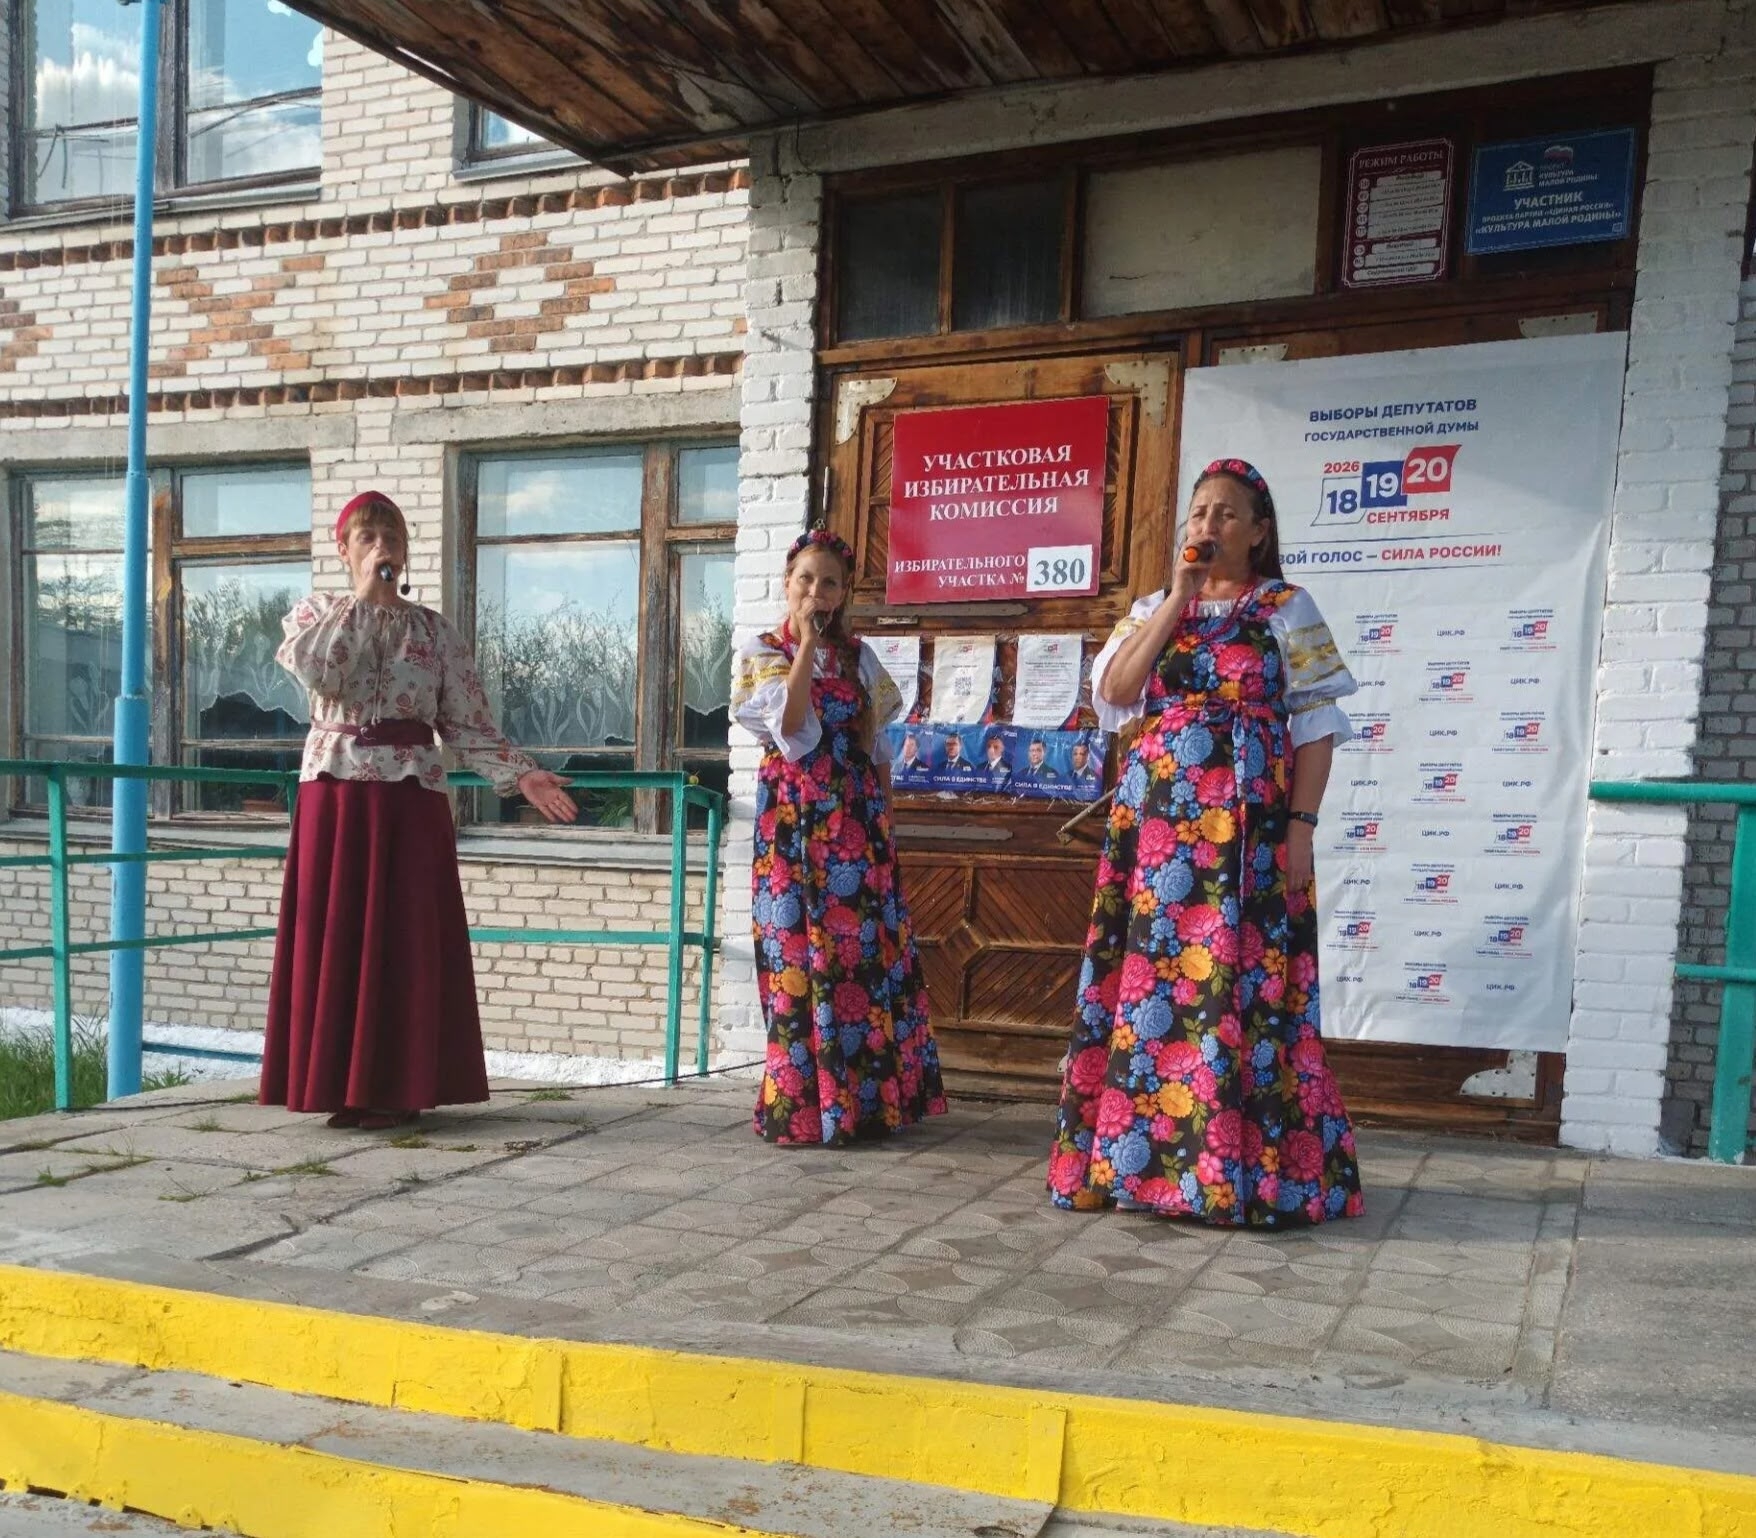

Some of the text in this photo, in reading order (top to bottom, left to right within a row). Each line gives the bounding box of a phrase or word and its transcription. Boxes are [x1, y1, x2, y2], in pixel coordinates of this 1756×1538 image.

[1400, 150, 1444, 165] РАБОТЫ
[1514, 191, 1584, 209] УЧАСТНИК
[1532, 215, 1569, 228] МАЛОЙ
[1571, 211, 1621, 224] РОДИНЫ»
[1309, 399, 1477, 422] ВЫБОРЫ ДЕПУТАТОВ
[1304, 421, 1479, 442] ГОСУДАРСТВЕННОЙ ДУМЫ
[923, 444, 1072, 473] УЧАСТКОВАЯ
[1323, 461, 1360, 474] 2026
[904, 469, 1090, 499] ИЗБИРАТЕЛЬНАЯ
[1326, 456, 1448, 515] 18 19 20
[930, 497, 1058, 521] КОМИССИЯ
[1367, 508, 1450, 524] СЕНТЯБРЯ
[894, 555, 1025, 573] ИЗБИРАТЕЛЬНОГО
[1279, 550, 1307, 565] ВОЙ
[1311, 550, 1363, 564] ГОЛОС
[1381, 548, 1425, 561] СИЛА
[1429, 544, 1502, 559] РОССИИ!
[938, 572, 1025, 588] УЧАСТКА №
[1034, 557, 1085, 586] 380
[957, 776, 986, 784] ЕДИНСТВЕ
